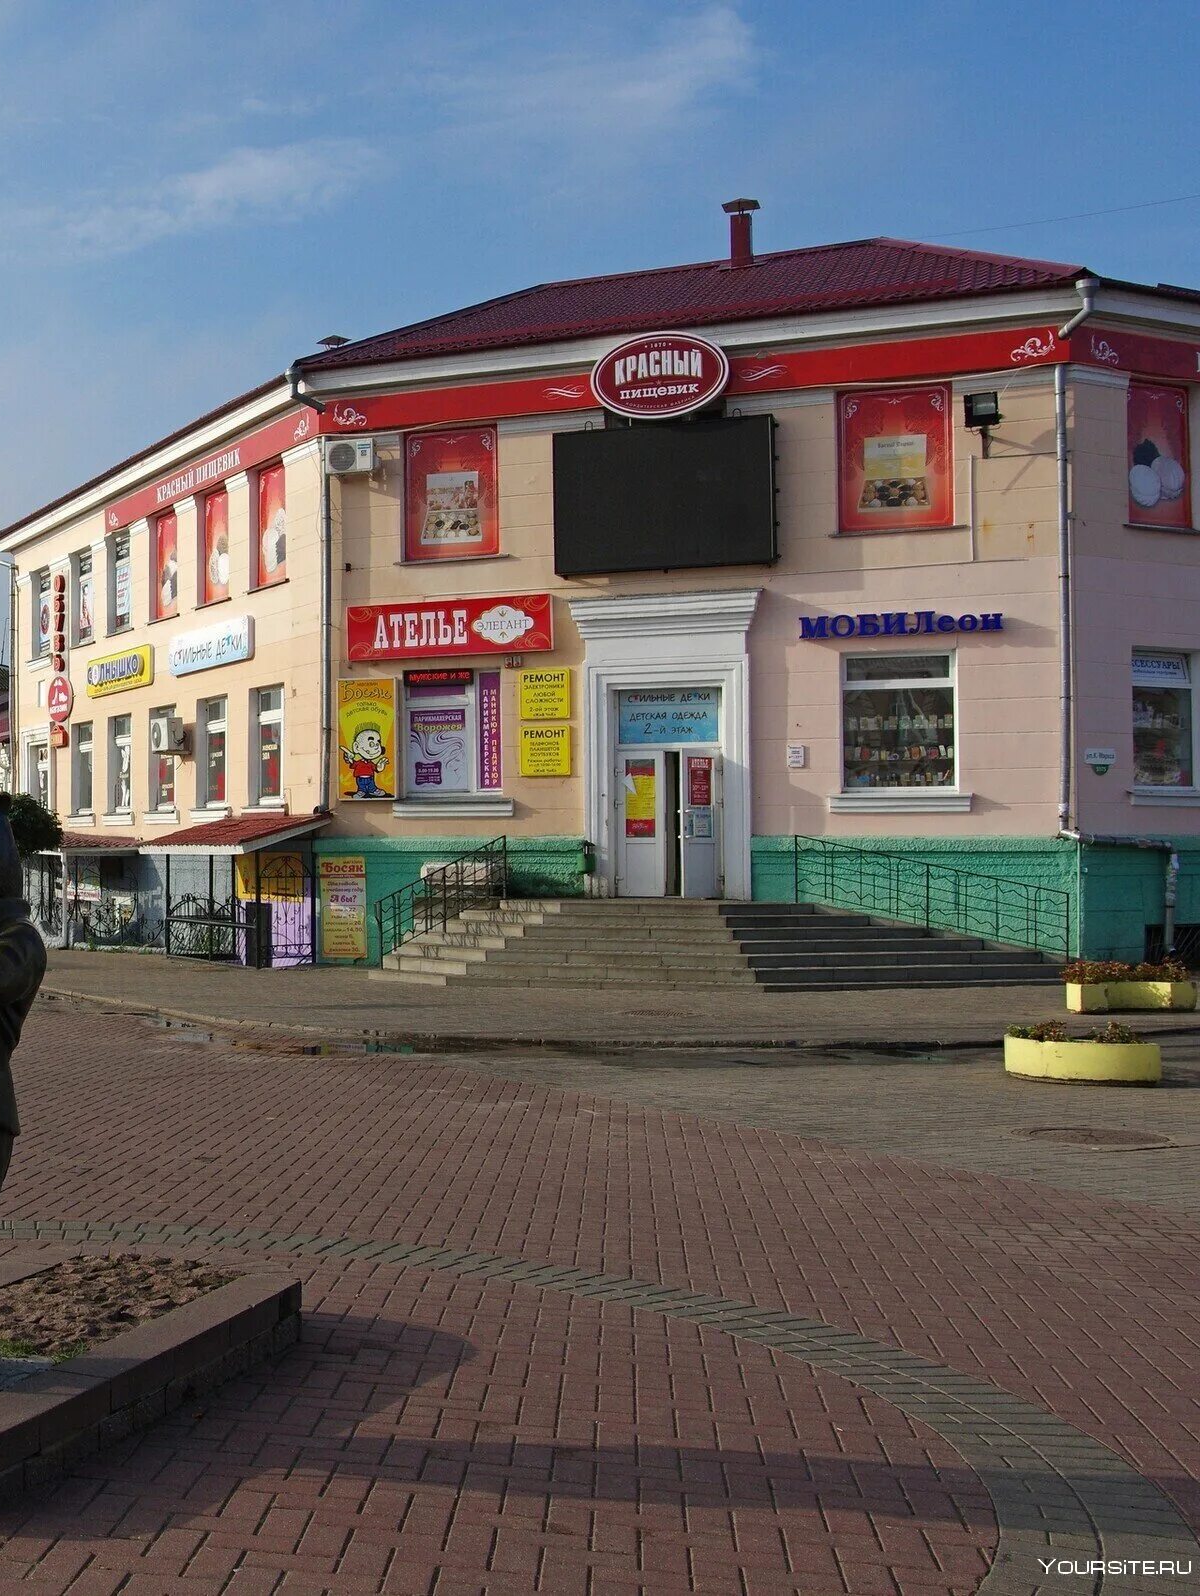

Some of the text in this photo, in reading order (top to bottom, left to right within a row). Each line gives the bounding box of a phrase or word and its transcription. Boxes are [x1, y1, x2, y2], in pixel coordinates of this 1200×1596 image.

[614, 348, 702, 386] КРАСНЫЙ
[156, 448, 240, 503] КРАСНЫЙ ПИЩЕВИК
[54, 574, 65, 672] ОБУВЬ
[373, 609, 530, 649] АТЕЛЬЕ ЭЛЕГАНТ
[799, 610, 1003, 640] МОБИЛеон
[173, 633, 243, 667] СТИЛЬНЫЕ ДЕТКИ
[87, 654, 139, 686] СОЛНЫШКО
[523, 673, 565, 683] РЕМОНТ
[341, 680, 391, 702] Босяк
[525, 697, 564, 705] СЛОЖНОСТИ
[533, 690, 556, 698] ЛЮБОЙ
[628, 692, 710, 703] СТИЛЬНЫЕ ДЕТКИ
[629, 711, 707, 722] ДЕТСКАЯ ОДЕЖДА
[490, 689, 499, 785] МАНИКЮР ПЕДИКЮР
[523, 729, 565, 739] РЕМОНТ
[321, 862, 363, 873] Босяк
